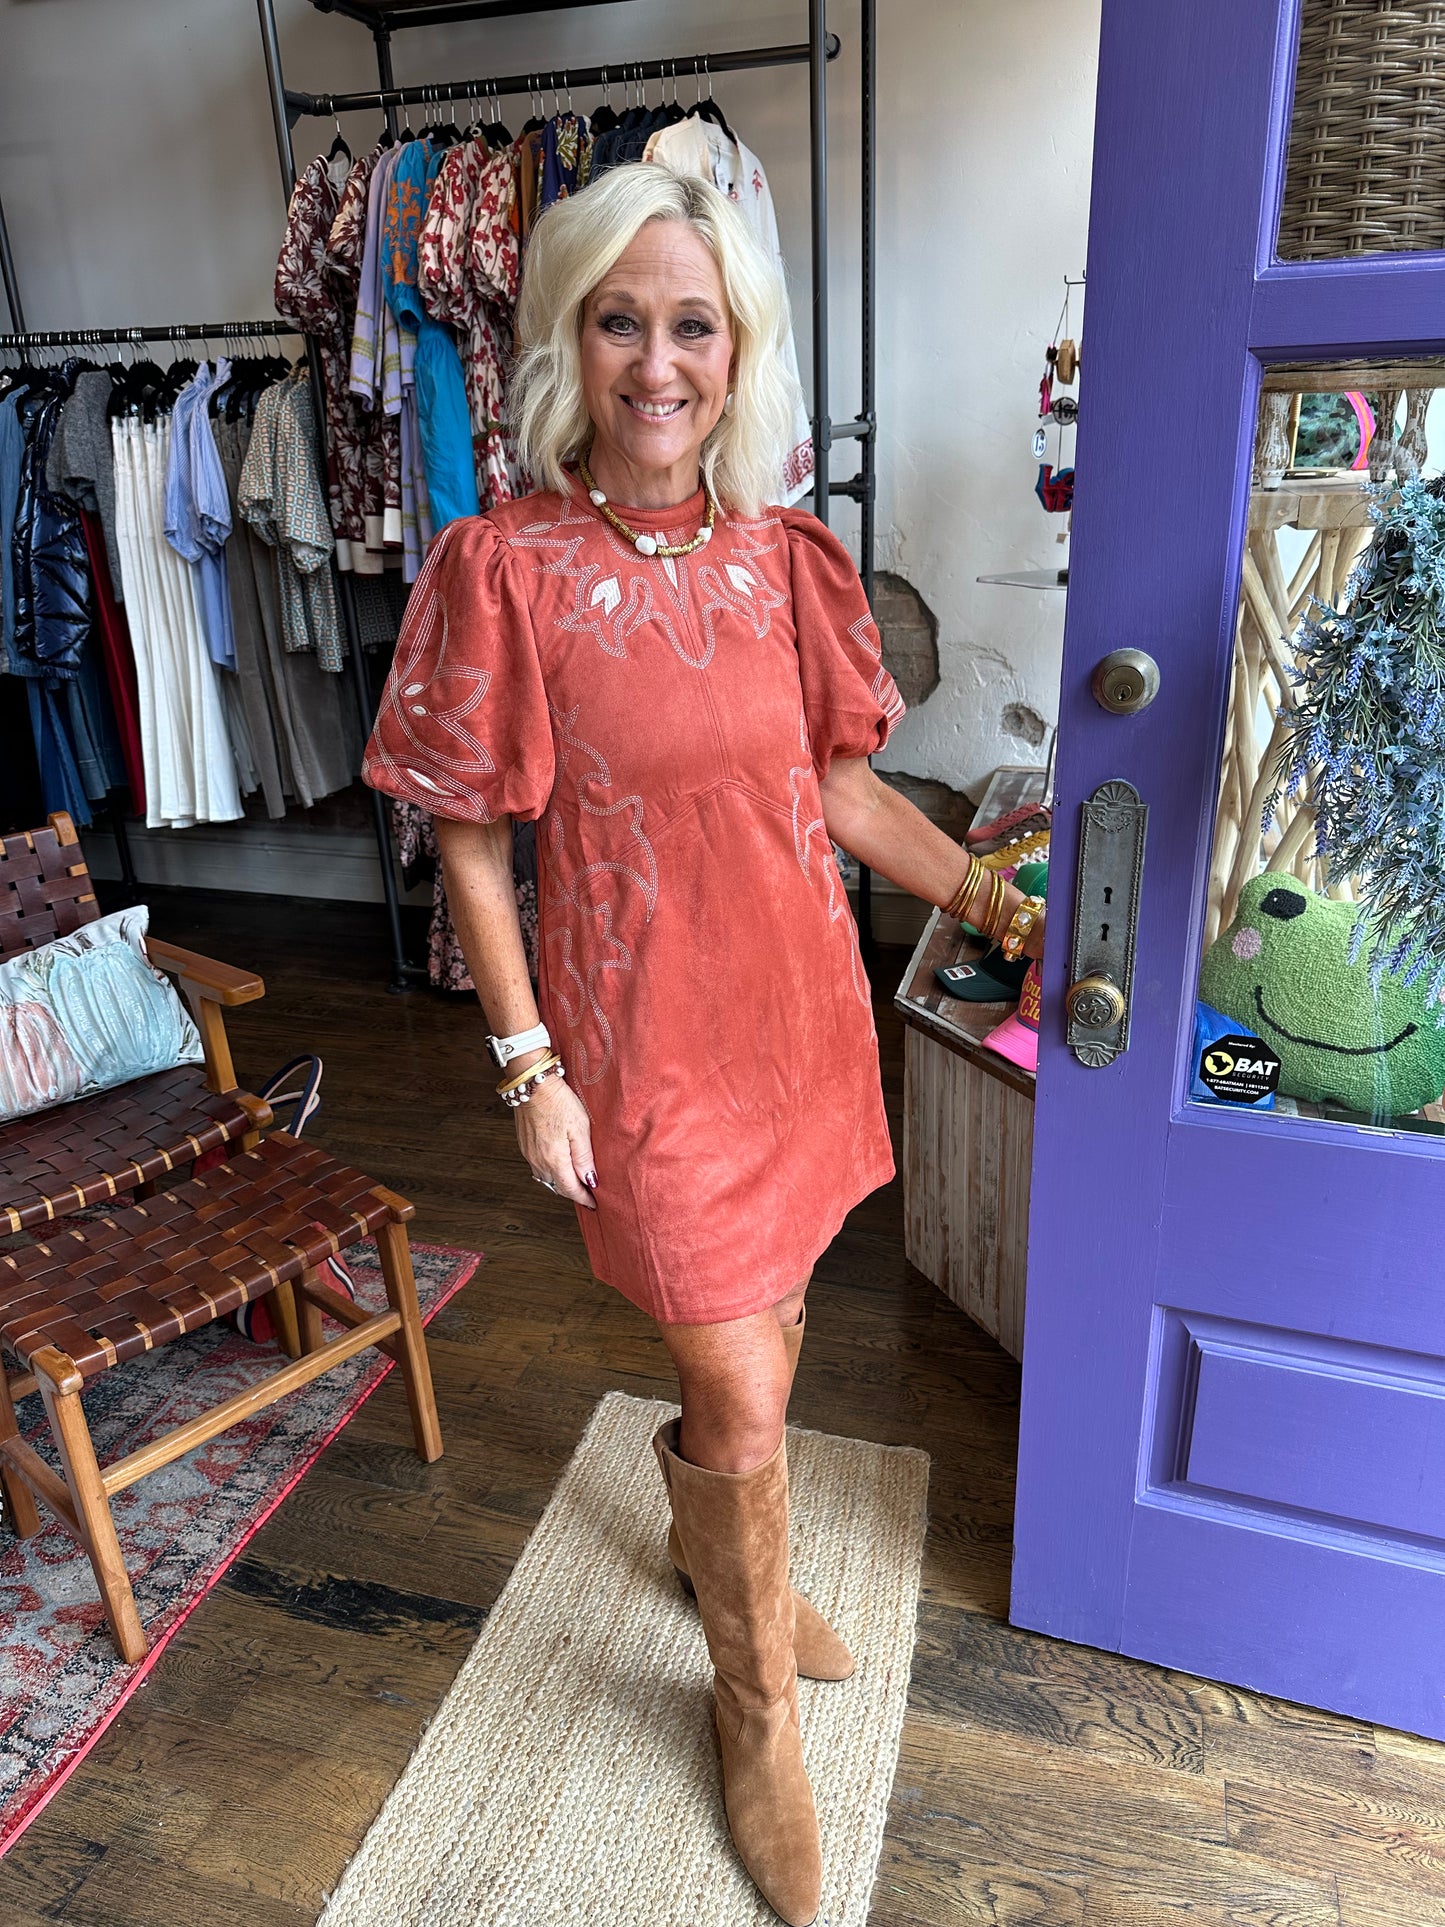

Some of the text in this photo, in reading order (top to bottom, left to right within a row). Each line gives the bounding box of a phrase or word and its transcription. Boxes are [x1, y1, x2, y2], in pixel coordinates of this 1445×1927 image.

[1021, 971, 1041, 1000] Cou
[1020, 995, 1041, 1021] Clu
[1233, 1057, 1279, 1076] BAT
[1232, 1072, 1270, 1081] SECURITY
[1214, 1085, 1260, 1095] BATSECURITY.COM
